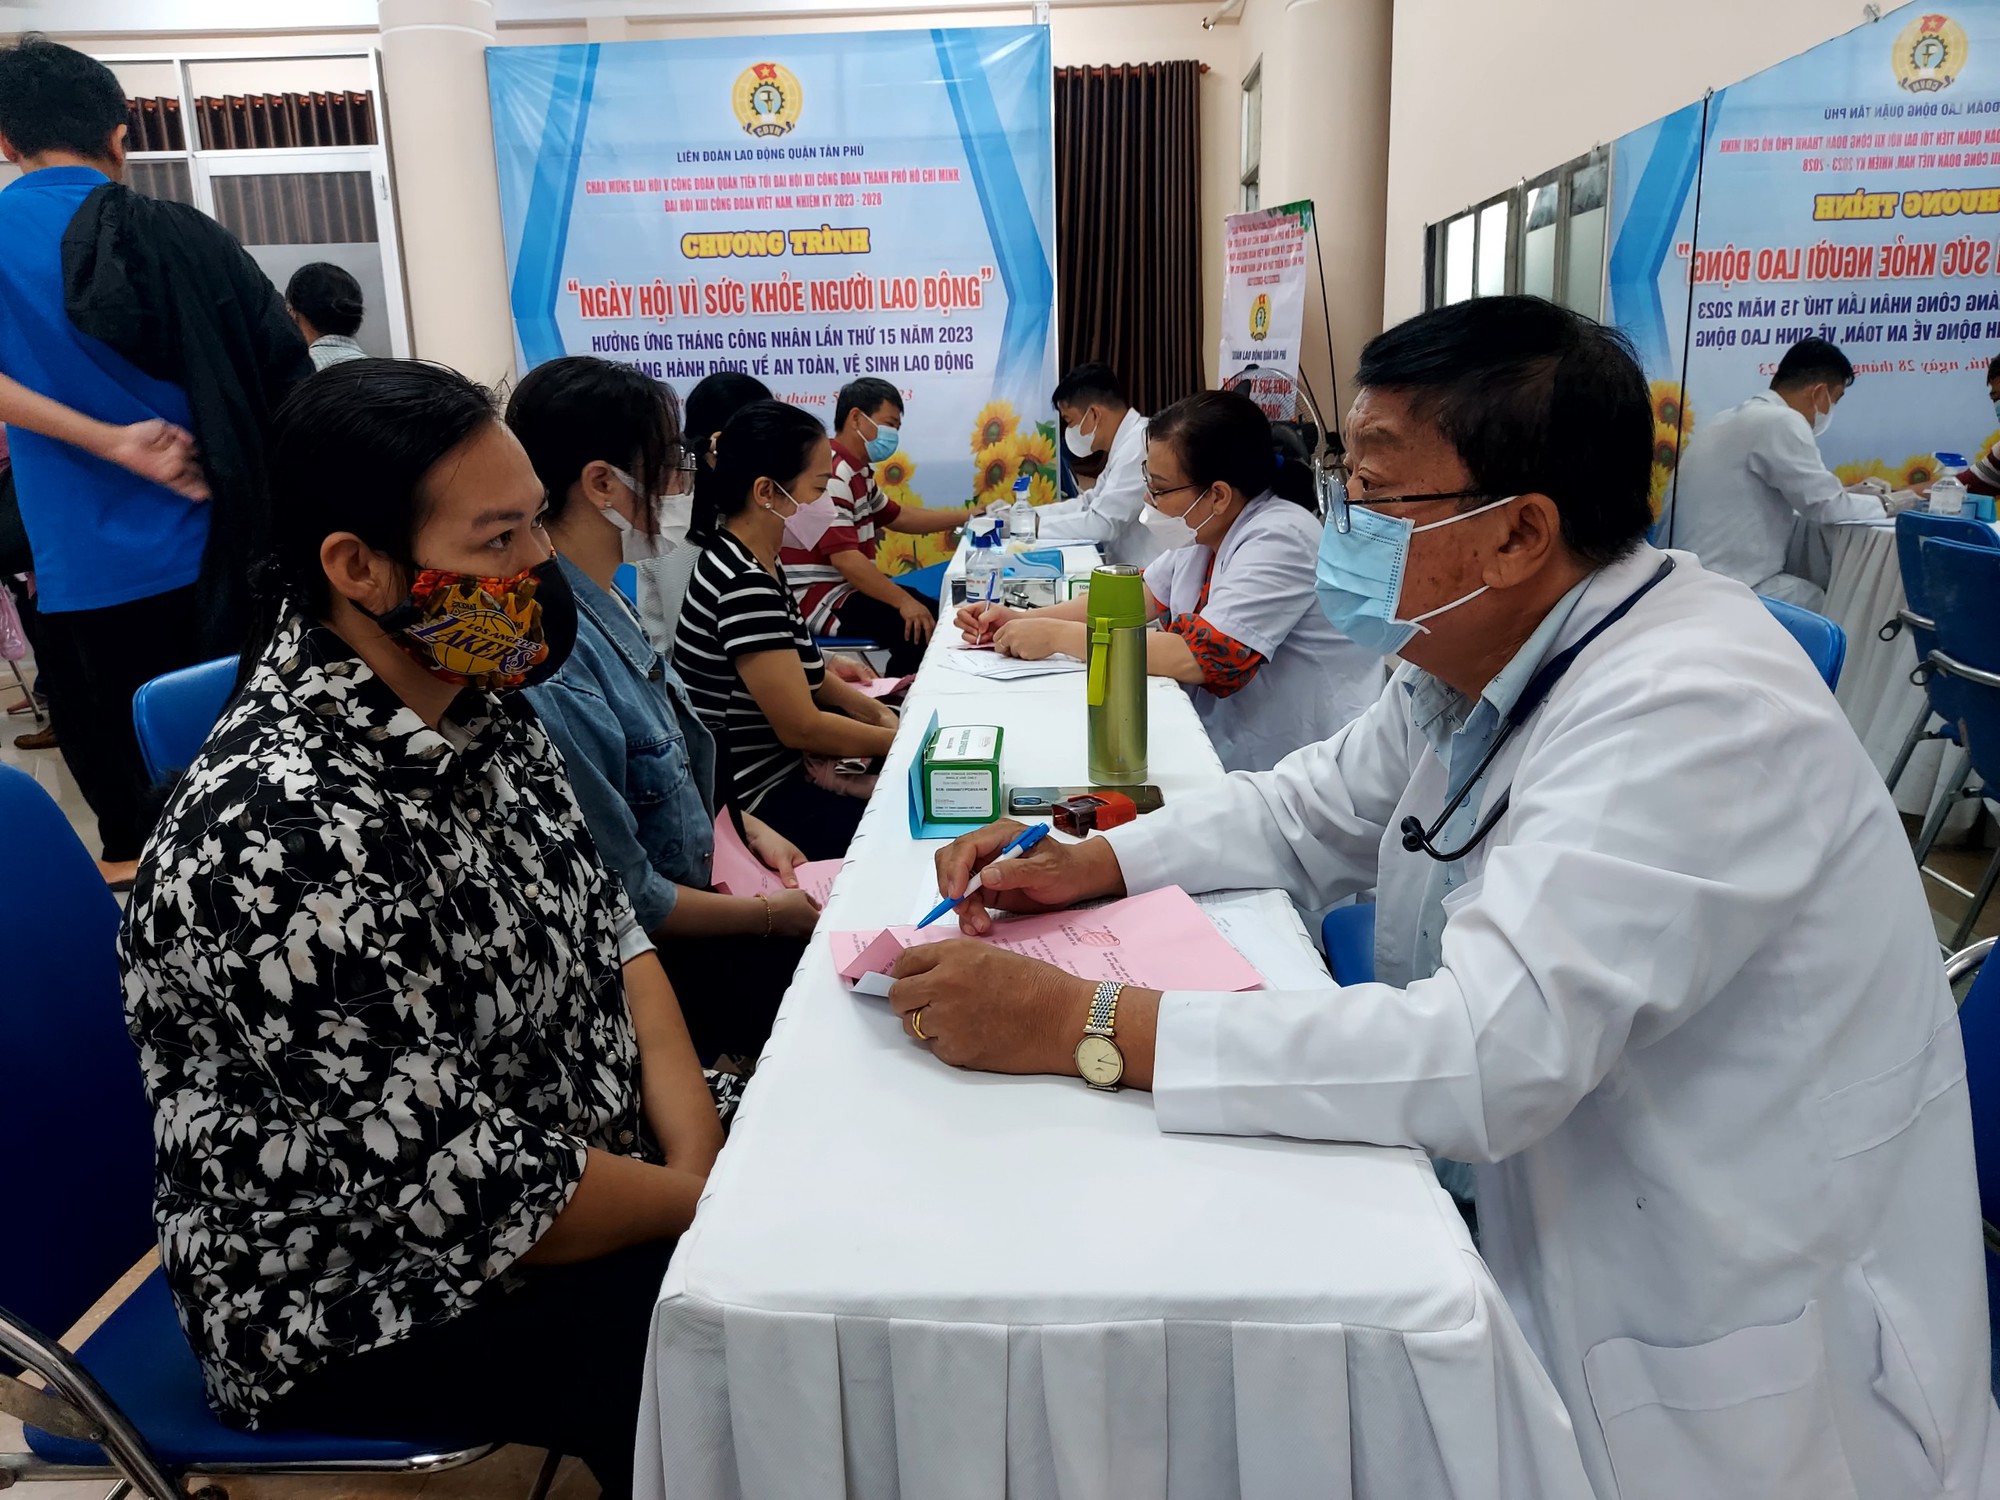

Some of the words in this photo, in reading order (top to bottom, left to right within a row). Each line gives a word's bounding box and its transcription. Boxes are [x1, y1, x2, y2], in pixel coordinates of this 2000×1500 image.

[677, 149, 700, 163] LIÊN
[703, 148, 731, 162] ĐOÀN
[734, 149, 753, 161] LAO
[757, 146, 785, 162] ĐỘNG
[788, 144, 817, 161] QUẬN
[820, 144, 840, 158] TÂN
[843, 143, 864, 156] PHÚ
[788, 224, 871, 256] TRÌNH
[640, 279, 673, 322] HỘI
[678, 278, 698, 314] VÌ
[705, 277, 744, 314] SỨC
[751, 271, 804, 313] KHỎE
[810, 273, 873, 312] NGƯỜI
[880, 277, 918, 309] LAO
[592, 330, 639, 352] HƯỞNG
[644, 330, 673, 350] ỨNG
[677, 330, 723, 350] THÁNG
[728, 329, 767, 349] CÔNG
[771, 327, 811, 347] NHÂN
[815, 324, 843, 347] LẦN
[847, 325, 876, 345] THỨ
[879, 328, 896, 345] 15
[901, 324, 934, 344] NĂM
[938, 326, 973, 343] 2023
[666, 357, 705, 378] HÀNH
[752, 354, 769, 375] VỀ
[774, 357, 793, 375] AN
[797, 354, 839, 375] TOÀN,
[843, 354, 860, 376] VỆ
[865, 356, 899, 373] SINH
[903, 355, 929, 371] LAO
[934, 351, 974, 374] ĐỘNG
[786, 391, 826, 406] tháng
[410, 615, 536, 674] LAKERS
[466, 624, 490, 635] LOS
[489, 632, 543, 651] ANGELES
